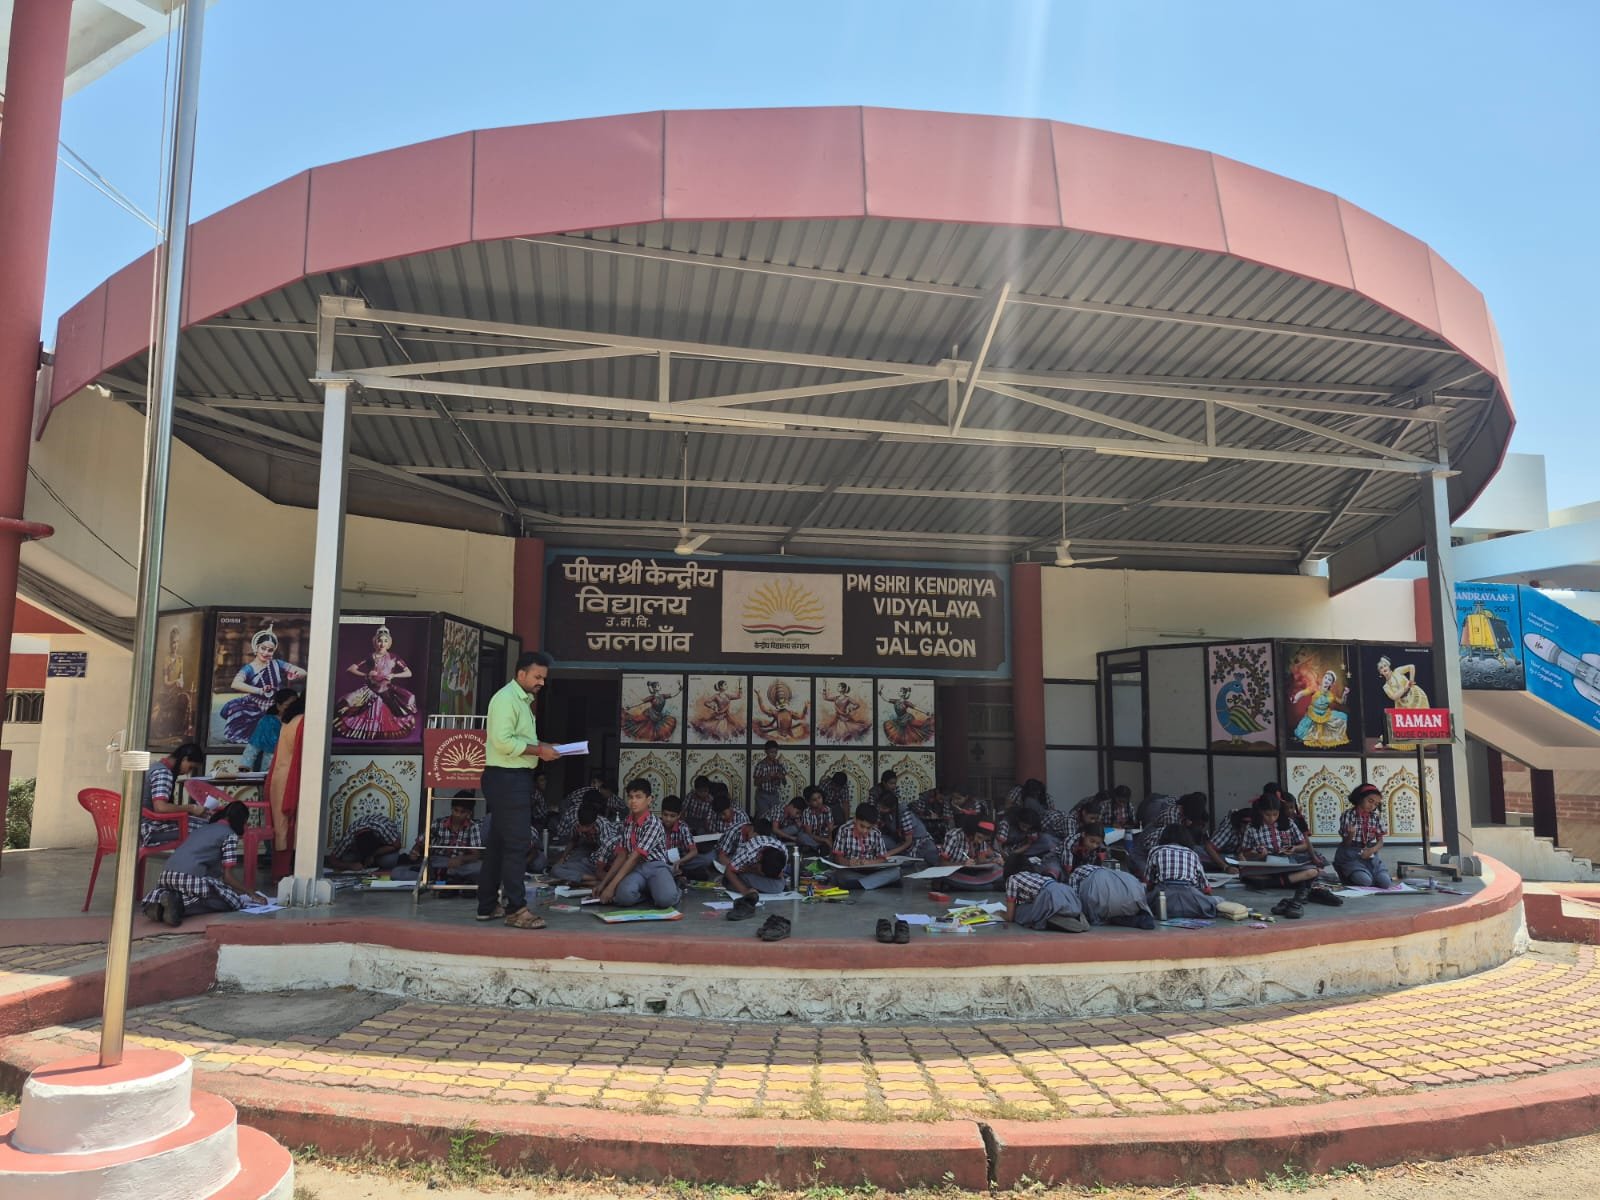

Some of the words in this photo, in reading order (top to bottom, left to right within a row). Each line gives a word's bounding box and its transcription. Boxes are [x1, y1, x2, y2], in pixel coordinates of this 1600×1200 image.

[562, 556, 616, 583] पीएम
[616, 559, 643, 584] श्री
[645, 559, 718, 590] केन्द्रीय
[846, 573, 871, 592] PM
[874, 574, 910, 594] SHRI
[914, 576, 996, 598] KENDRIYA
[575, 585, 692, 616] विद्यालय
[873, 597, 982, 619] VIDYALAYA
[586, 625, 694, 653] जलगाँव
[894, 620, 953, 636] N.M.U.
[1394, 713, 1442, 728] RAMAN
[436, 733, 463, 755] KENDRIYA
